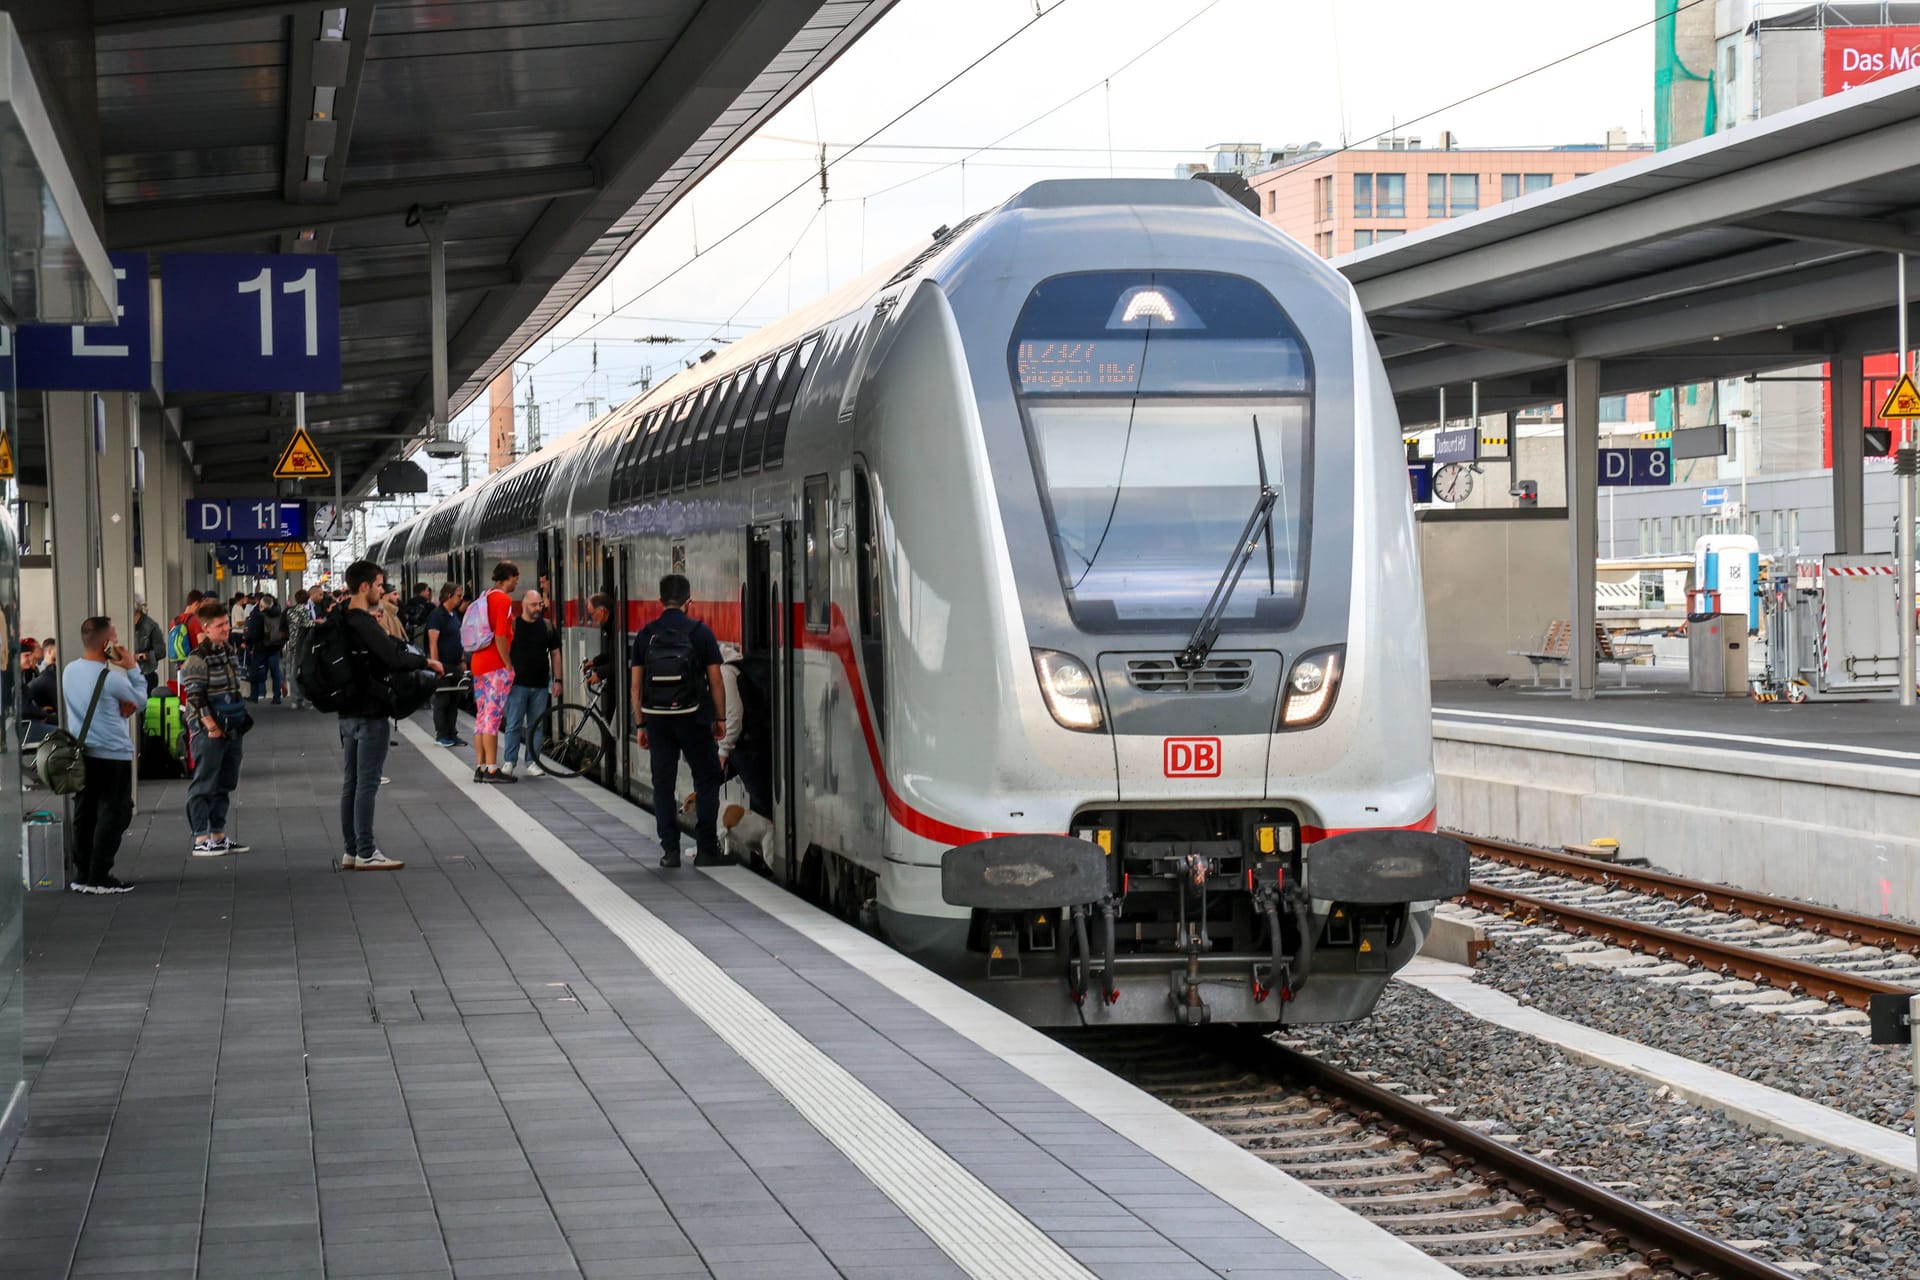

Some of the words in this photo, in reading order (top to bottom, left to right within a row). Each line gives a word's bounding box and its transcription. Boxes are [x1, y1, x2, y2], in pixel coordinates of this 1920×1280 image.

[1842, 48, 1884, 71] Das
[238, 267, 318, 356] 11
[1605, 452, 1625, 478] D
[1649, 451, 1666, 477] 8
[202, 503, 222, 530] D
[251, 502, 276, 529] 11
[1170, 743, 1215, 772] DB
